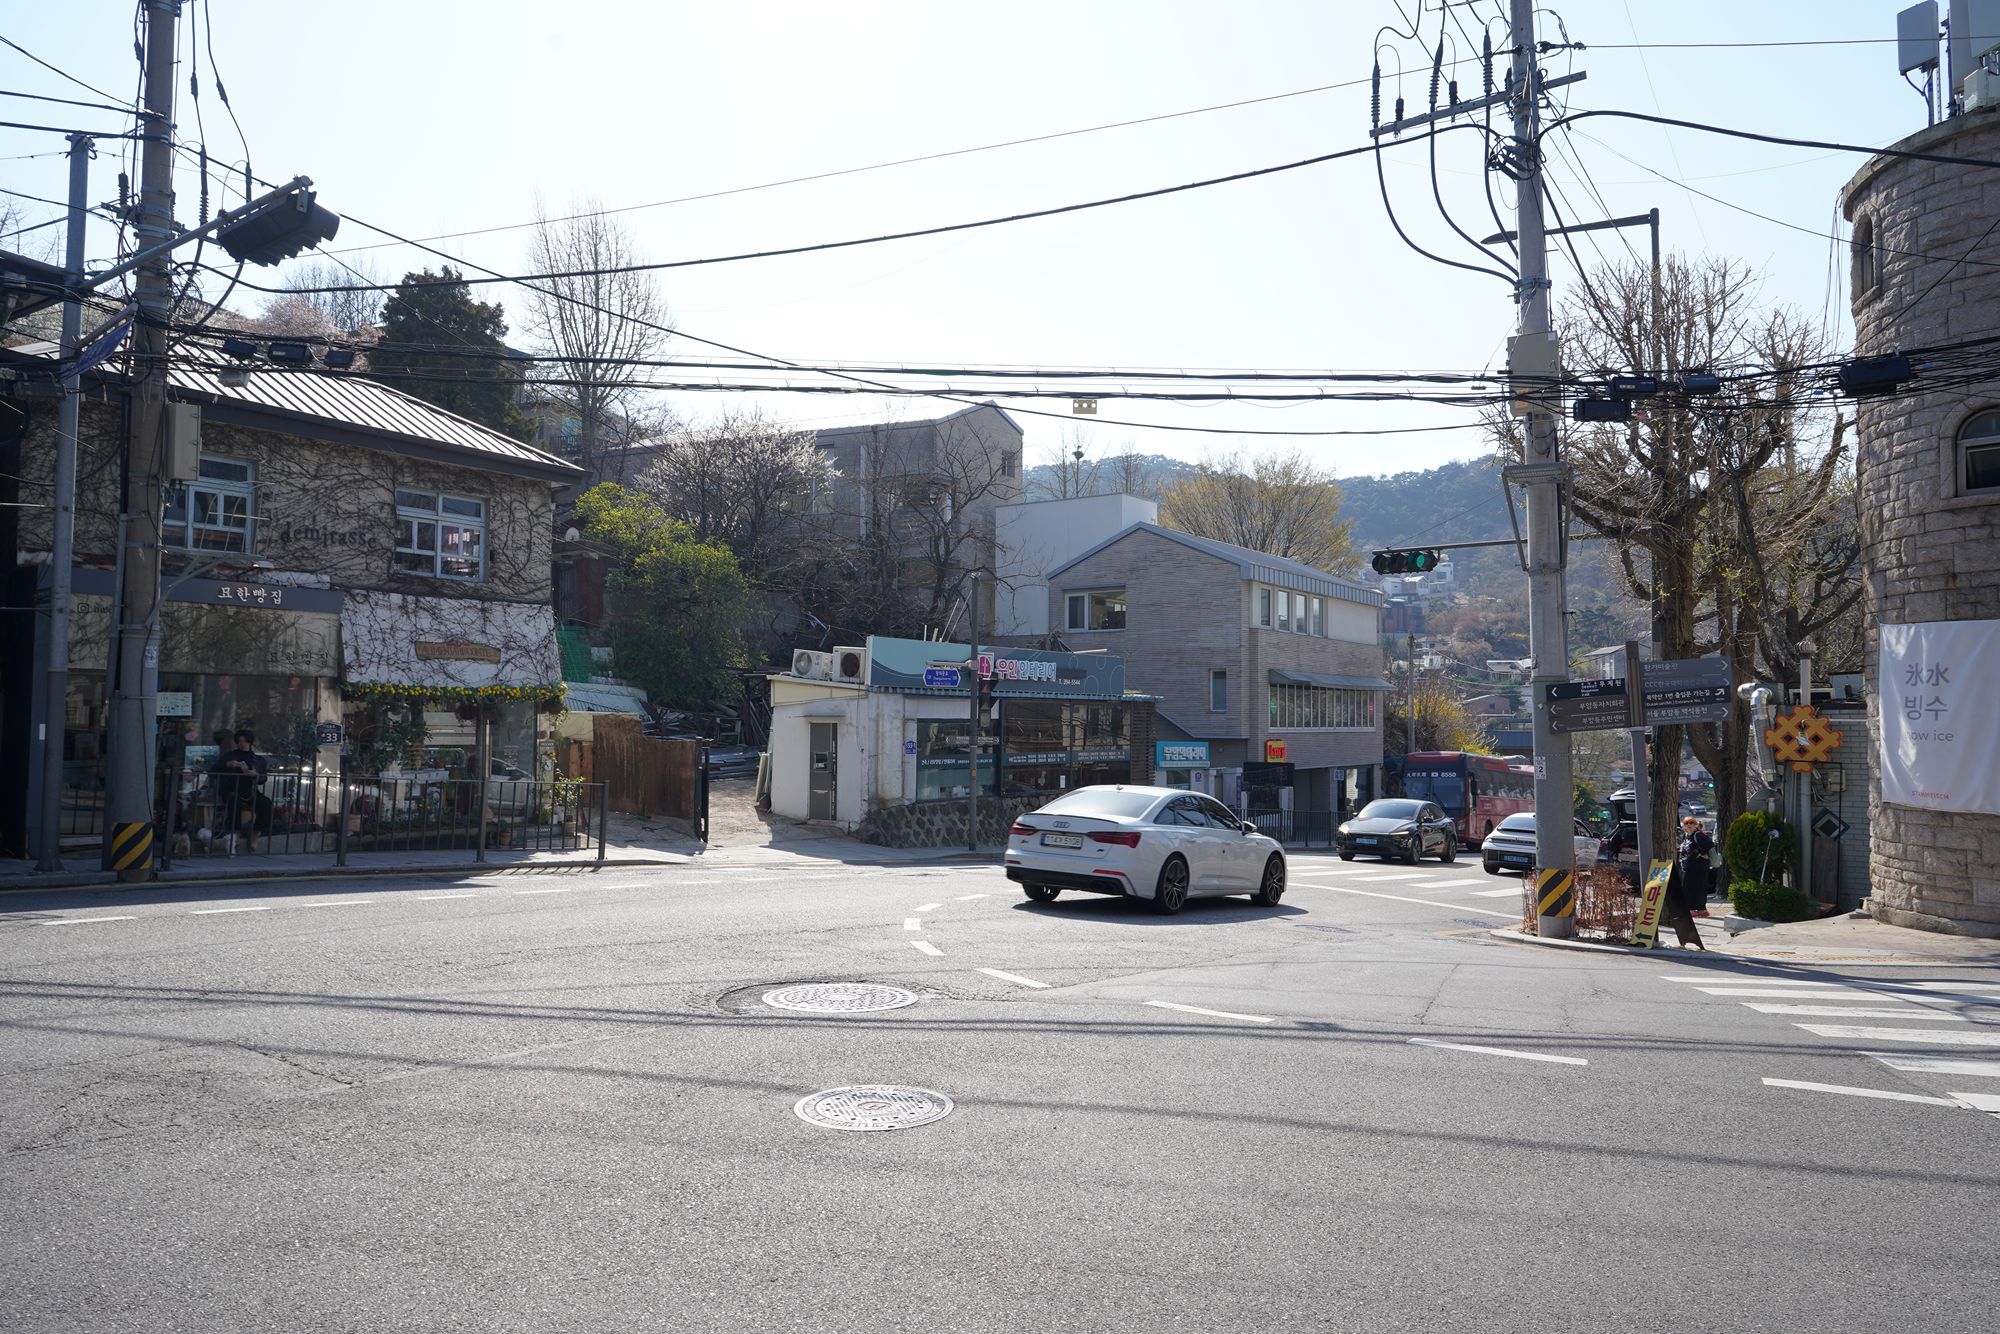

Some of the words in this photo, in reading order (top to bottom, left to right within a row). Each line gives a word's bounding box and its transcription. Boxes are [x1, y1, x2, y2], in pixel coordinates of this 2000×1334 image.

[217, 586, 282, 605] 묘한빵집
[1904, 695, 1948, 721] 빙수
[1933, 729, 1954, 742] ice
[1640, 886, 1662, 926] 마트
